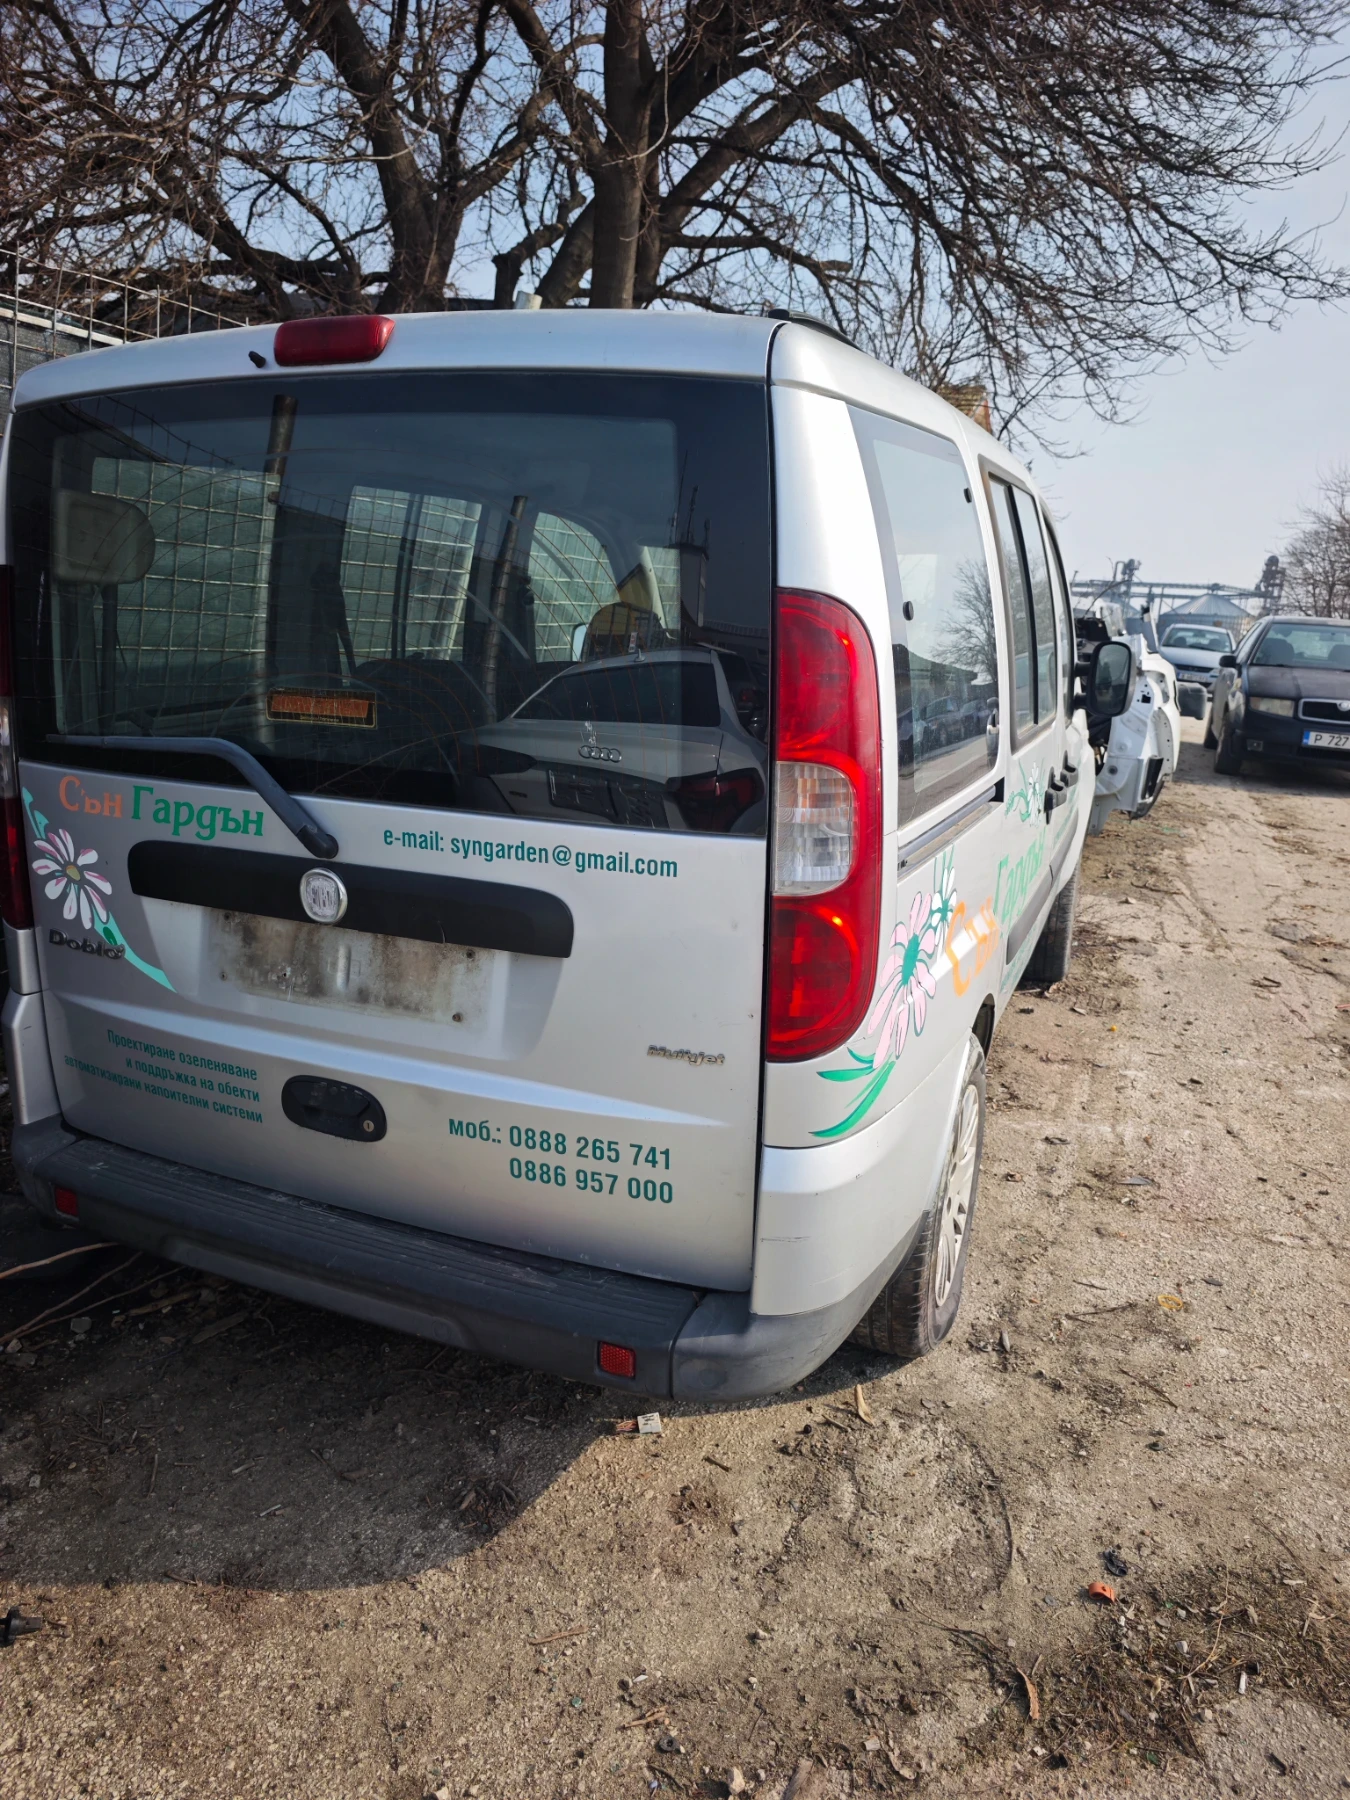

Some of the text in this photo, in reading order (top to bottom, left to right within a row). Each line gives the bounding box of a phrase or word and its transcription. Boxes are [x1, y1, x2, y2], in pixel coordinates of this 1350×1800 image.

[1314, 734, 1350, 748] P 727
[59, 776, 264, 841] Сън Гардън
[383, 829, 678, 877] e-mail: syngarden@gmail.com
[107, 1029, 257, 1081] Проектиране озеленяване
[64, 1054, 263, 1124] автоматизирани напоителни системи
[135, 1061, 197, 1087] поддръжка
[200, 1078, 214, 1091] на
[218, 1082, 260, 1103] обекти
[509, 1125, 567, 1155] 0888
[576, 1136, 620, 1163] 265
[630, 1143, 670, 1170] 741
[509, 1157, 673, 1204] 0886 957 000
